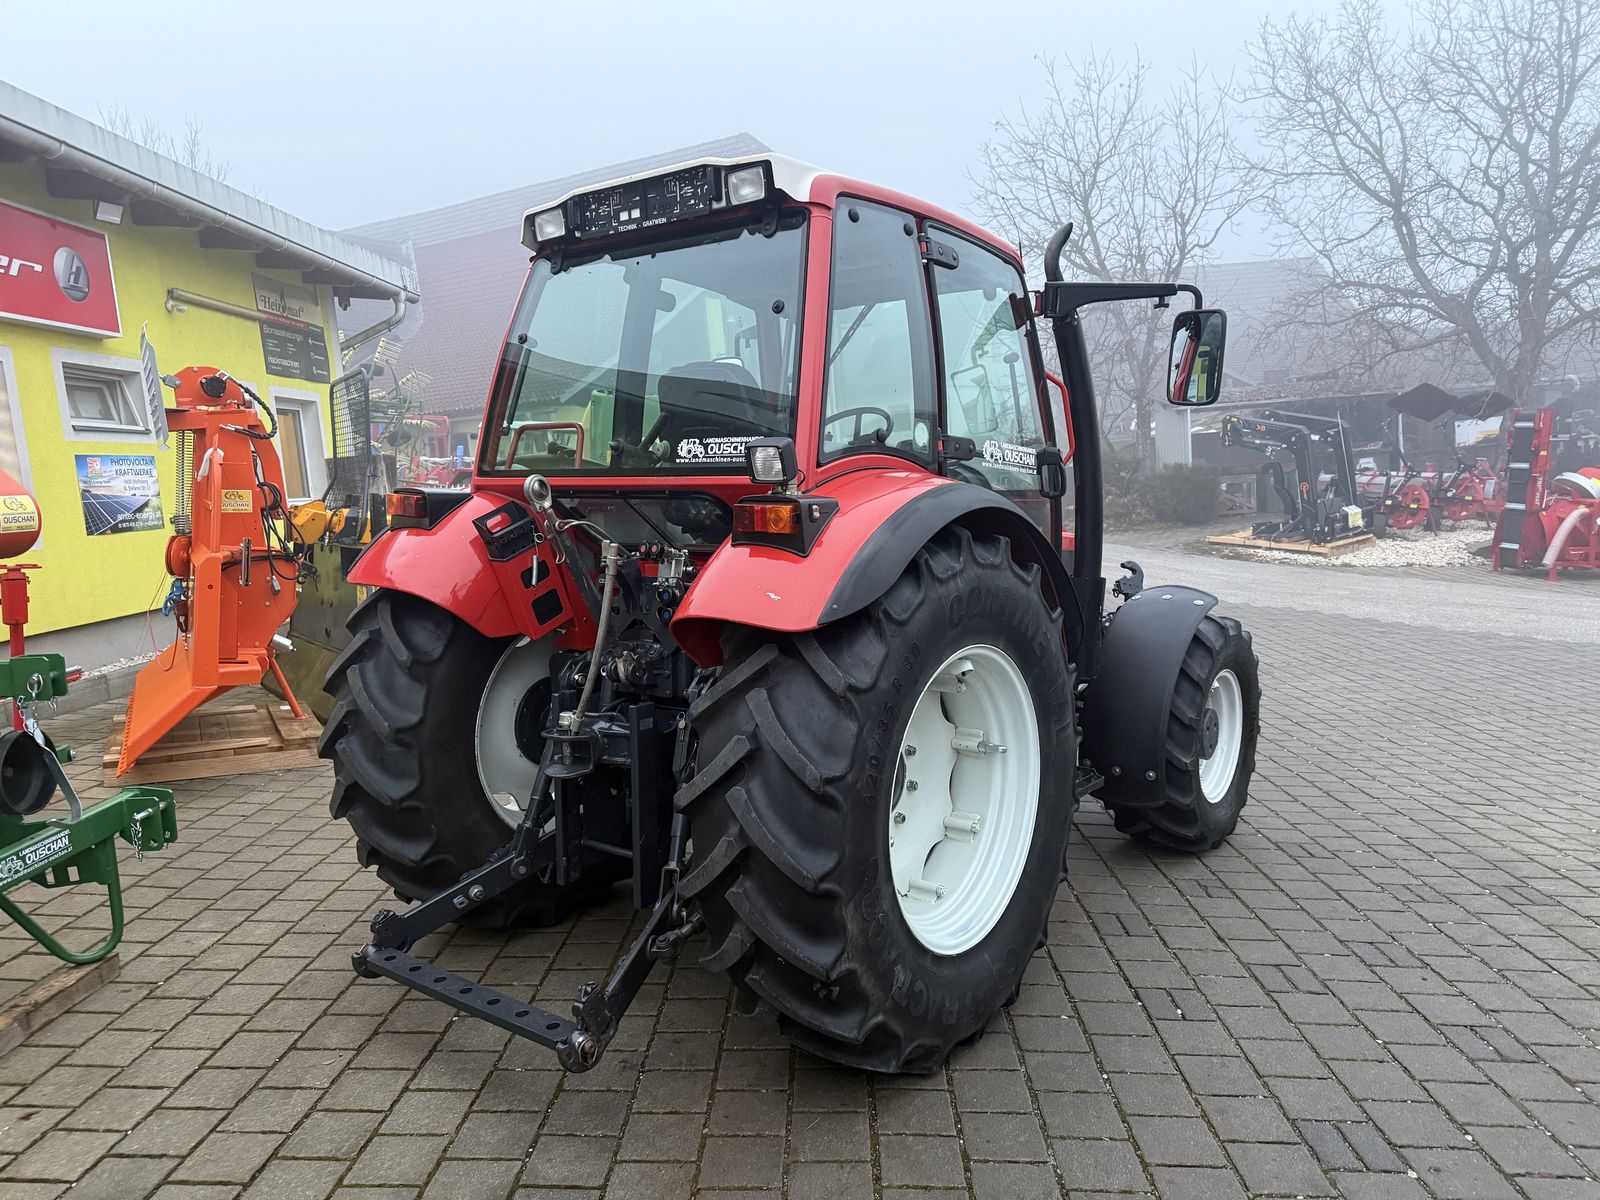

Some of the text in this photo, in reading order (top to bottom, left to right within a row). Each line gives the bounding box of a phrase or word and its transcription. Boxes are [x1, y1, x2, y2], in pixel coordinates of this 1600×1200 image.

[618, 223, 638, 232] TECHNIK
[642, 217, 667, 227] GRATWEIN
[707, 442, 747, 455] OUSCH
[110, 458, 155, 466] PHOTOVOLTAIK
[1004, 449, 1036, 466] OUSCHAN
[114, 468, 153, 476] KRAFTWERKE
[3, 515, 35, 524] OUSCHAN
[25, 835, 69, 864] OUSCHAN
